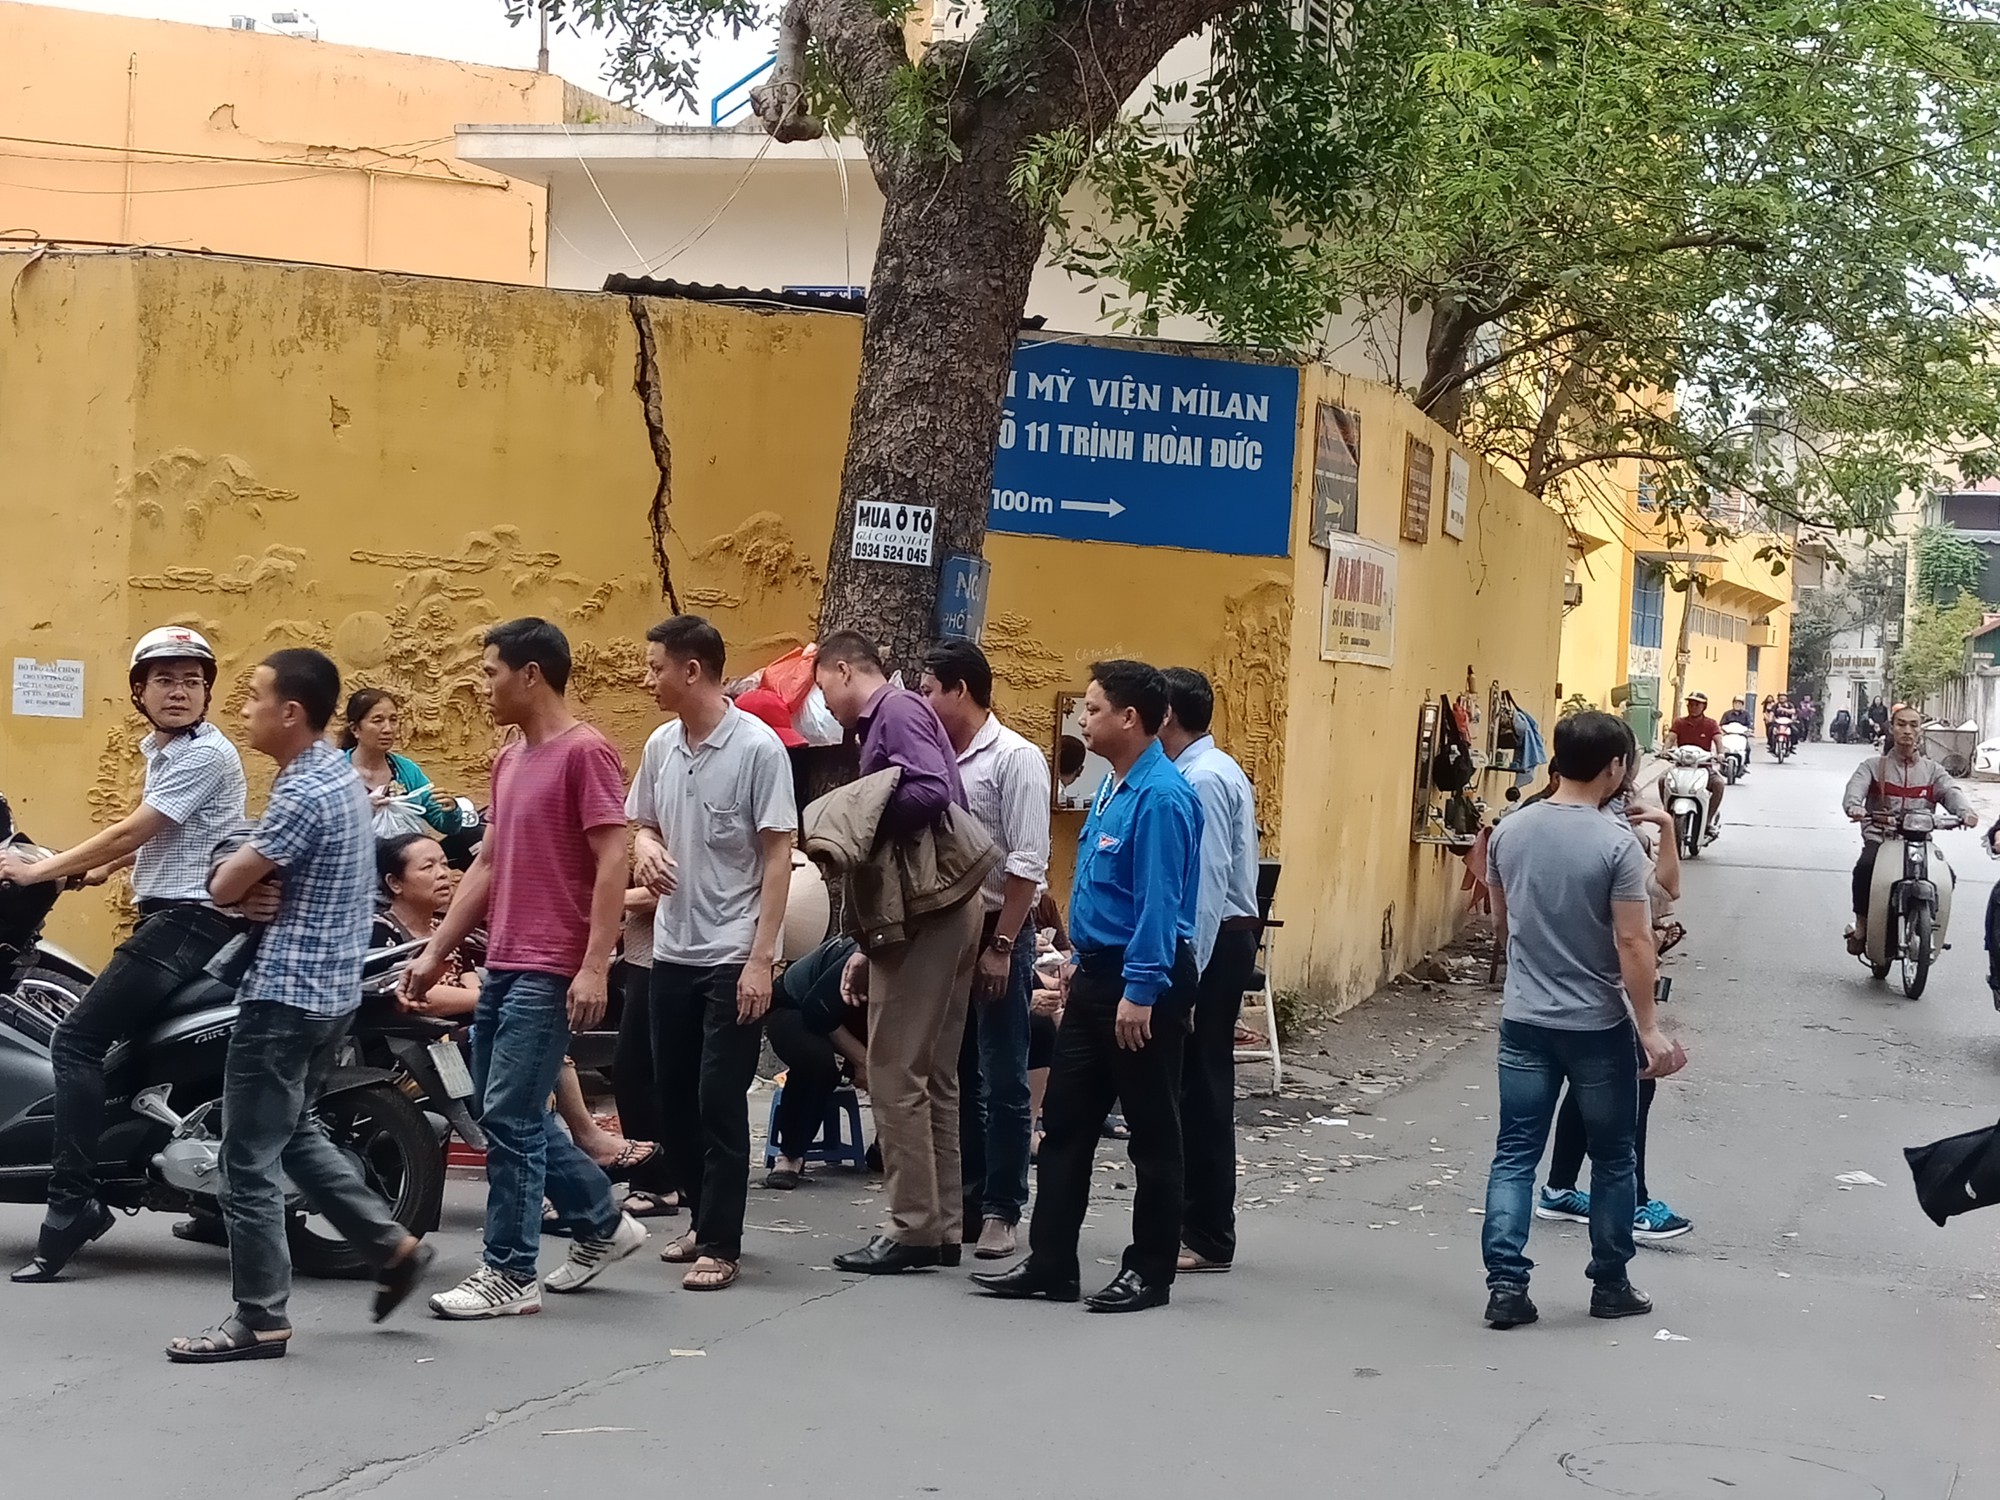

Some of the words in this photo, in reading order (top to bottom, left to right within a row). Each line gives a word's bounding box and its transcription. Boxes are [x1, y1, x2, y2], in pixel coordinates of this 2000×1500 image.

[1027, 368, 1076, 403] MỸ
[1087, 375, 1162, 415] VIỆN
[1025, 421, 1050, 452] 11
[1210, 431, 1263, 471] ĐỨC
[991, 488, 1053, 514] 100m
[858, 505, 891, 529] MUA
[896, 505, 908, 531] Ô
[912, 509, 932, 535] TÔ
[874, 532, 897, 542] CAO
[855, 542, 880, 558] 0934
[883, 544, 904, 561] 524
[906, 547, 927, 563] 045
